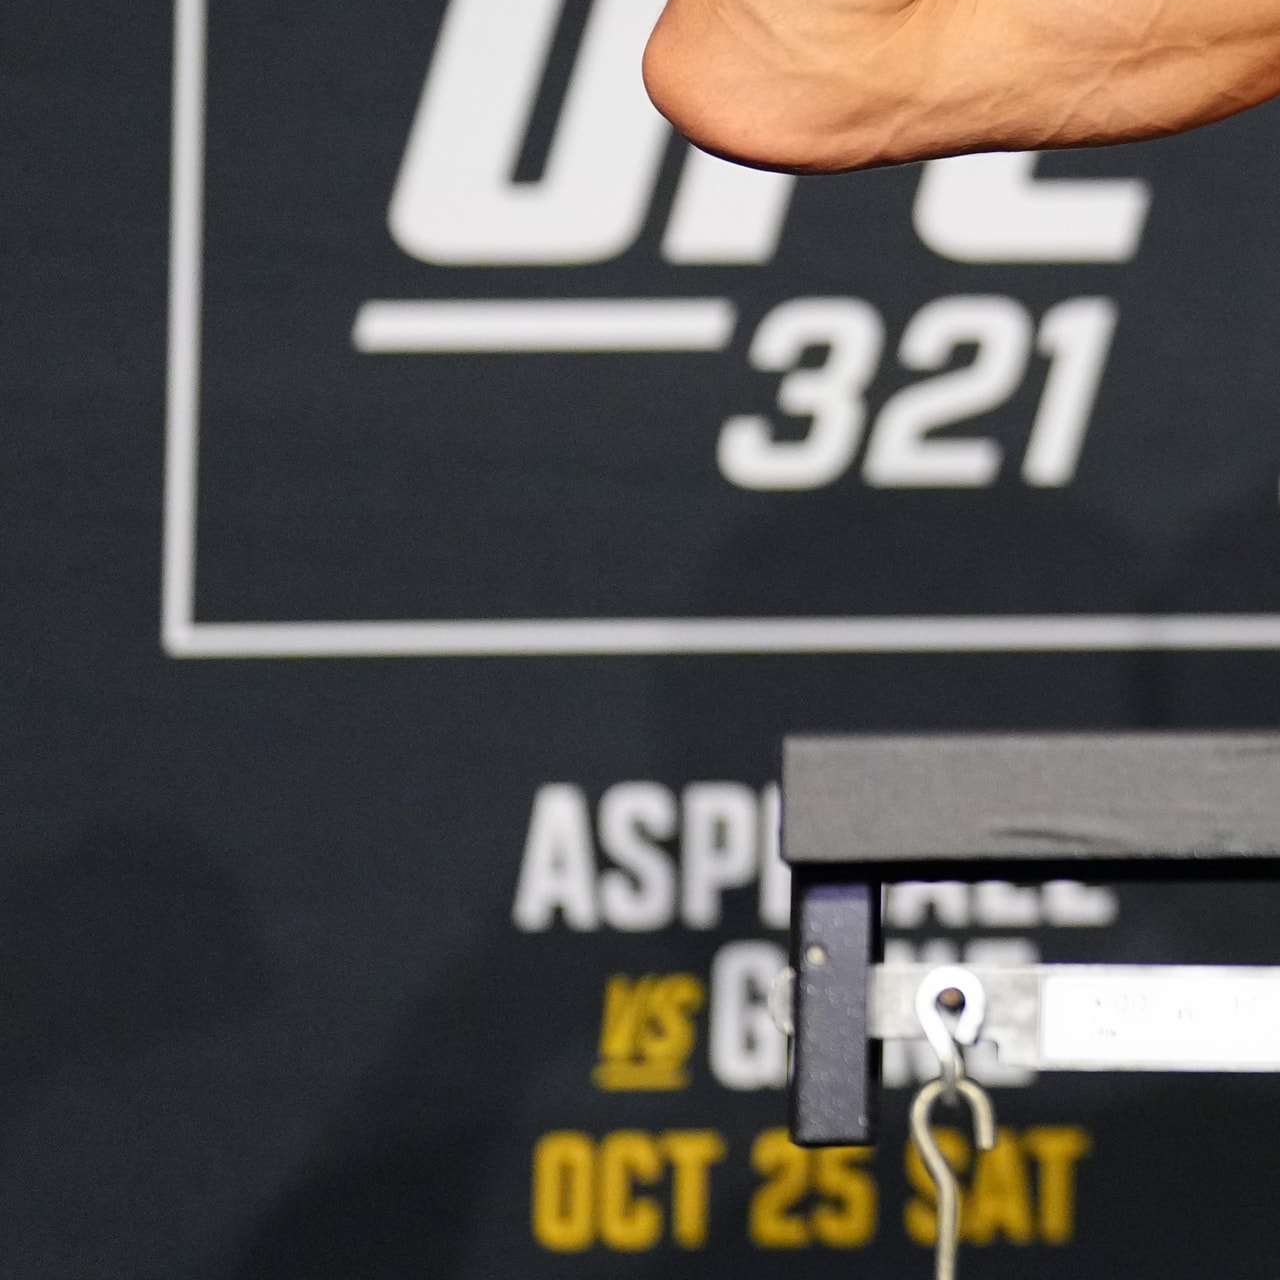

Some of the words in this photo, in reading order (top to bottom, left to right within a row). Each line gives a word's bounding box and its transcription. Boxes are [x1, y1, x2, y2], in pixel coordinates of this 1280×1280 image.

[716, 294, 1118, 491] 321
[602, 972, 706, 1066] VS
[532, 1130, 724, 1252] OCT
[749, 1126, 879, 1249] 25
[904, 1126, 1090, 1246] SAT
